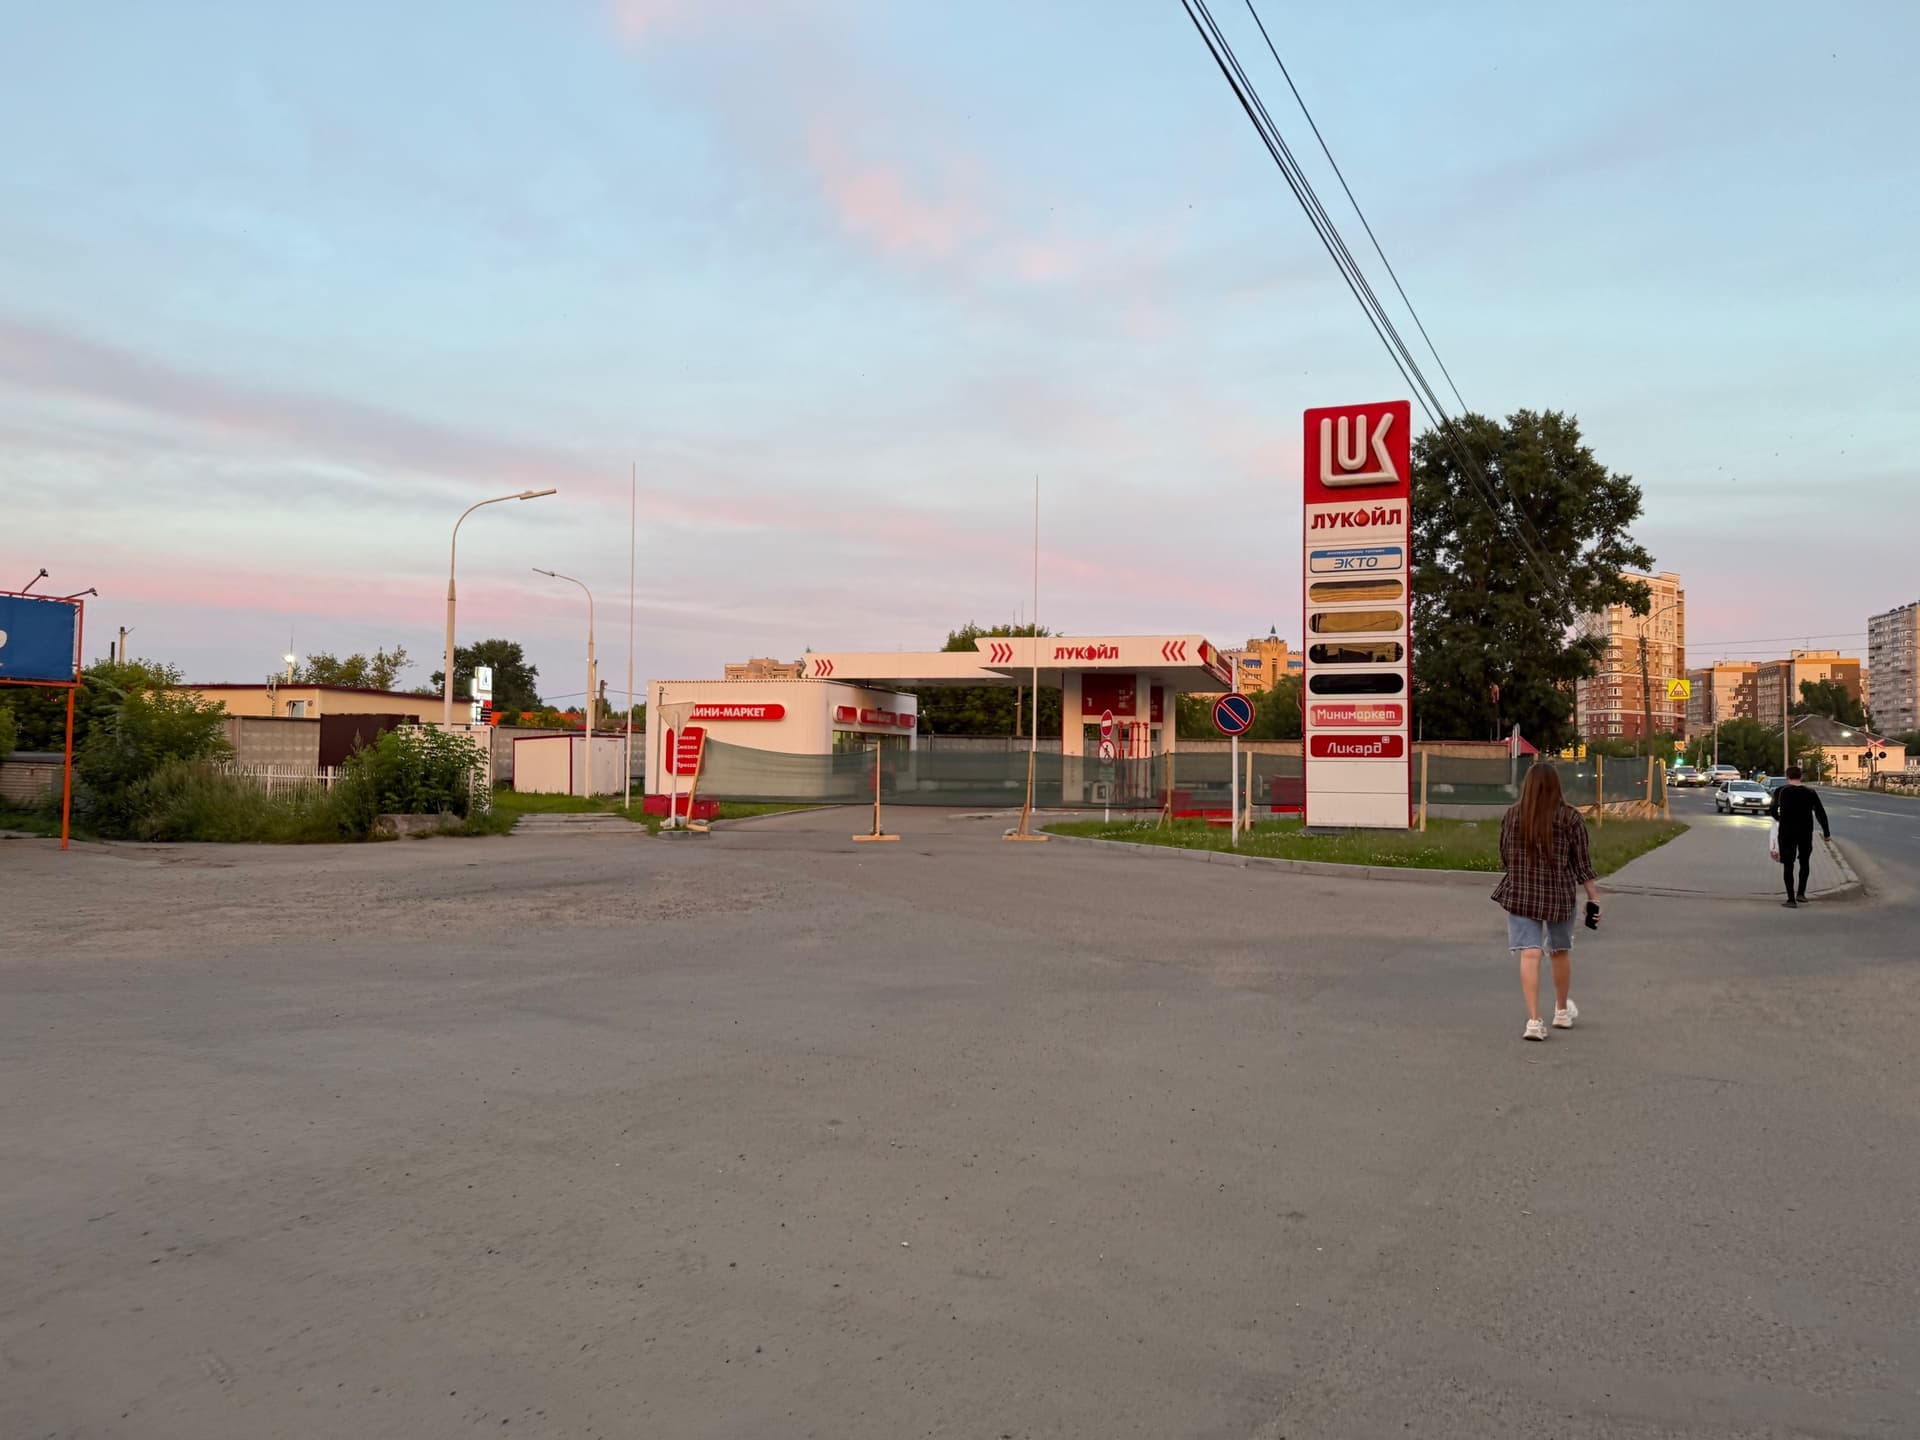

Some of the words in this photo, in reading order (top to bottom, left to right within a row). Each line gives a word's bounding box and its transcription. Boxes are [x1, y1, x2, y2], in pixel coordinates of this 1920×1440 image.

[1311, 506, 1401, 529] ЛУКОЙЛ
[1333, 557, 1378, 568] ЭКТО
[1054, 644, 1119, 660] ЛУКОЙЛ
[1316, 708, 1396, 721] Минимаркет
[1327, 742, 1382, 757] Ликард
